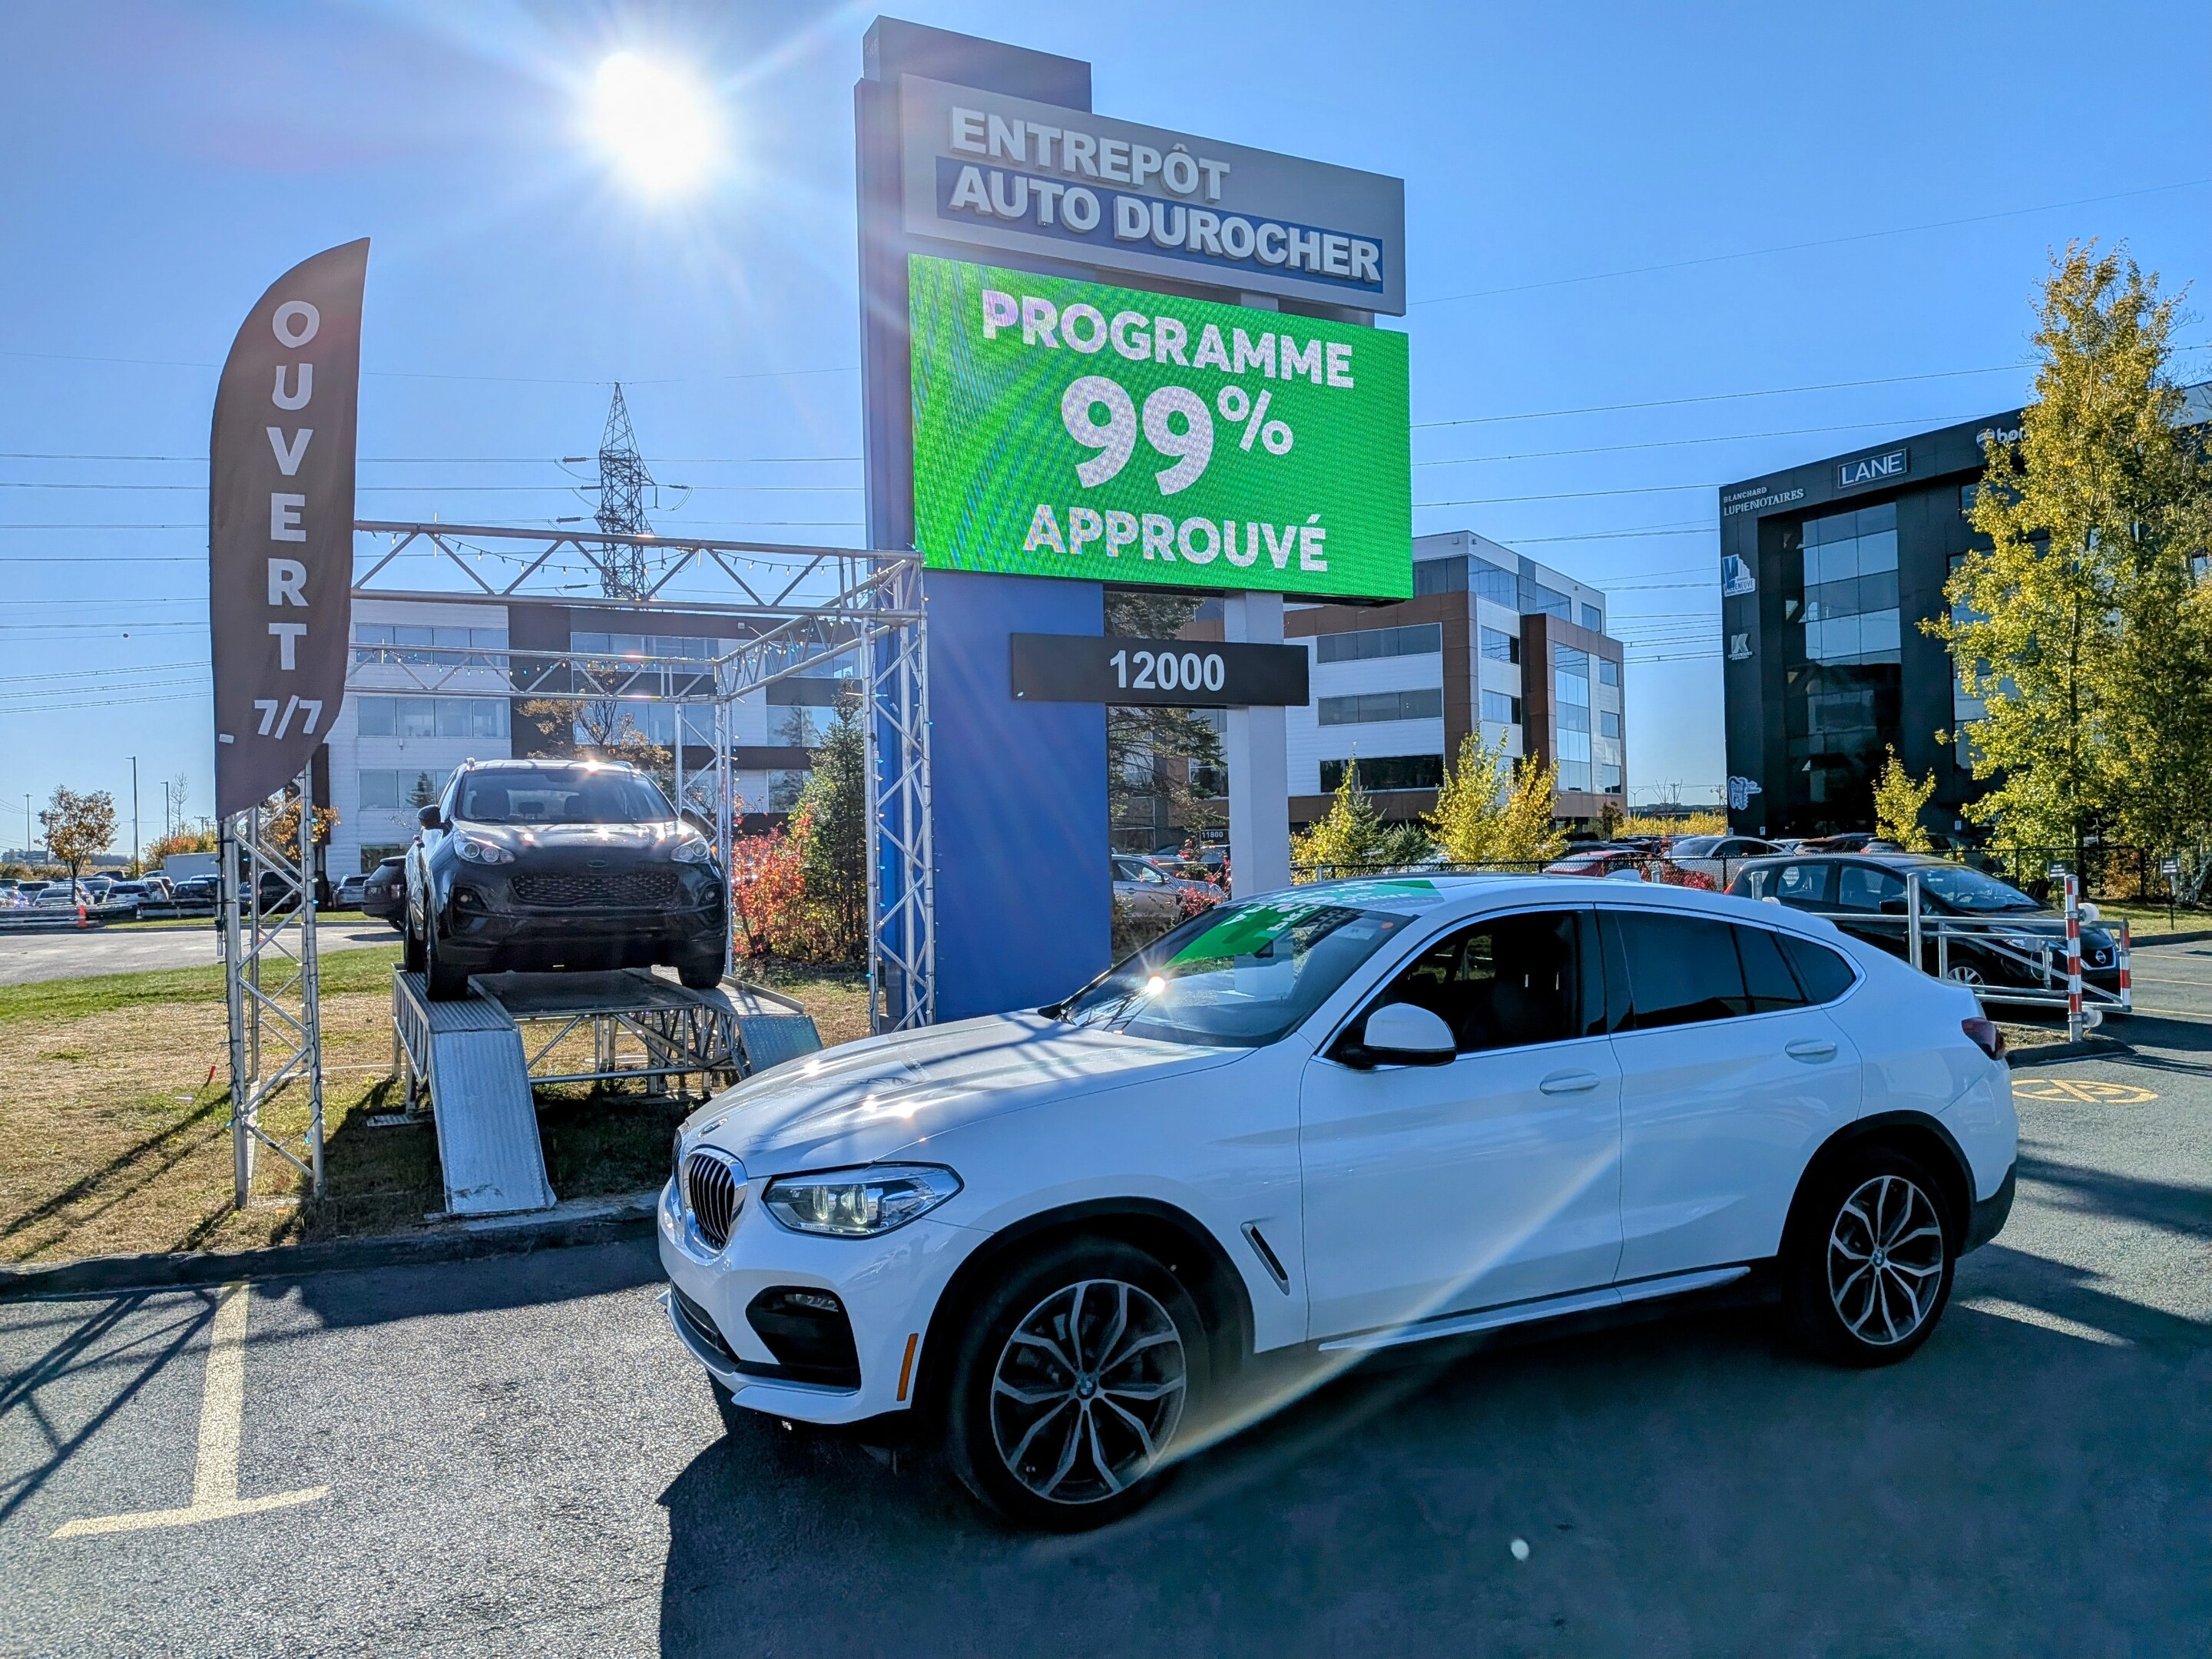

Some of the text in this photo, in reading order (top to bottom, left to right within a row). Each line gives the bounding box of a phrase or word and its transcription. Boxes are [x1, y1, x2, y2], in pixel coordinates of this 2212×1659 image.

[951, 106, 1230, 203] ENTREPÔT
[949, 165, 1382, 283] AUTO DUROCHER
[982, 289, 1354, 389] PROGRAMME
[1061, 375, 1293, 496] 99%
[1842, 452, 1902, 485] LANE
[265, 300, 320, 671] OUVERT
[1724, 486, 1767, 503] BLANCHARD
[1022, 504, 1328, 572] APPROUVÉ
[1110, 650, 1225, 691] 12000
[254, 694, 323, 740] 7/7
